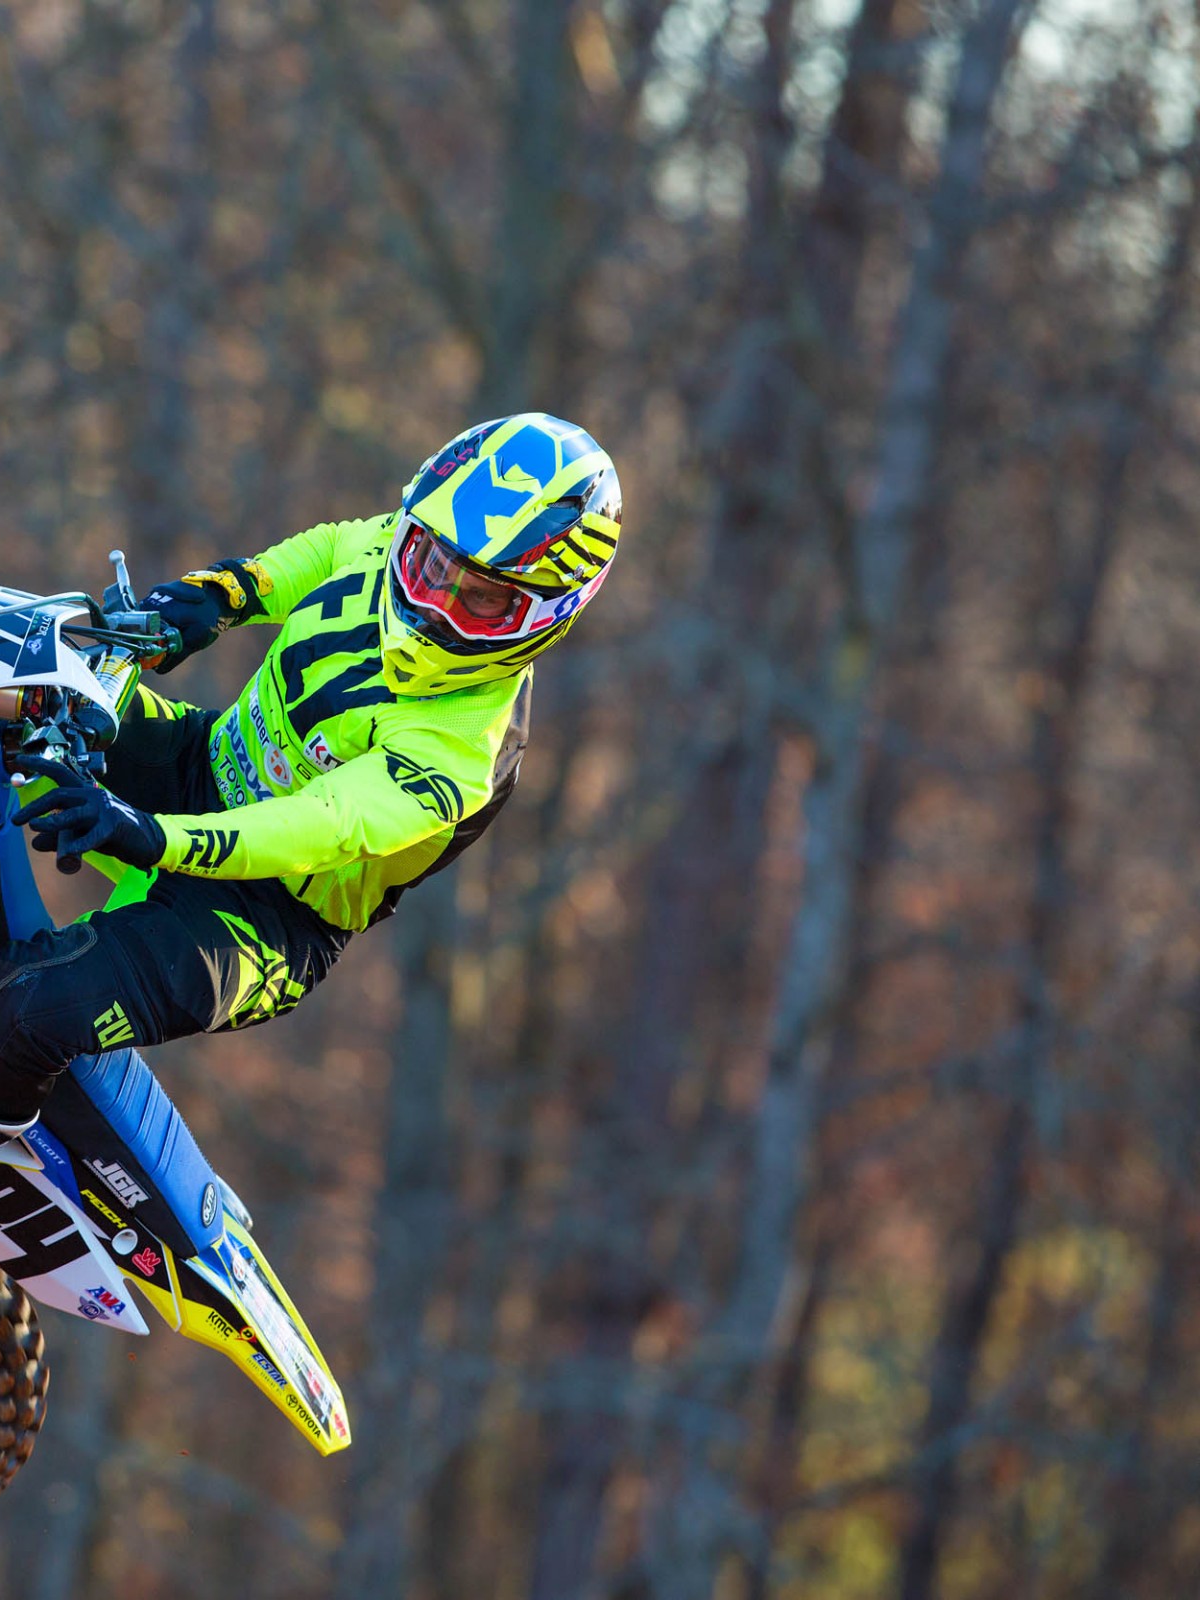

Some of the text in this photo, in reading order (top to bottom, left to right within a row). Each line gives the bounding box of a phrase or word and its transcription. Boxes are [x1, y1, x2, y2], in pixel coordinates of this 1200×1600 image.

[181, 828, 240, 868] FLY
[175, 865, 217, 875] RACING
[94, 1000, 135, 1049] FLY
[35, 1137, 67, 1166] SCOTT
[92, 1158, 150, 1208] JGR
[85, 1286, 126, 1315] AMA
[251, 1352, 288, 1388] ECSTAR
[295, 1404, 321, 1439] TOYOTA
